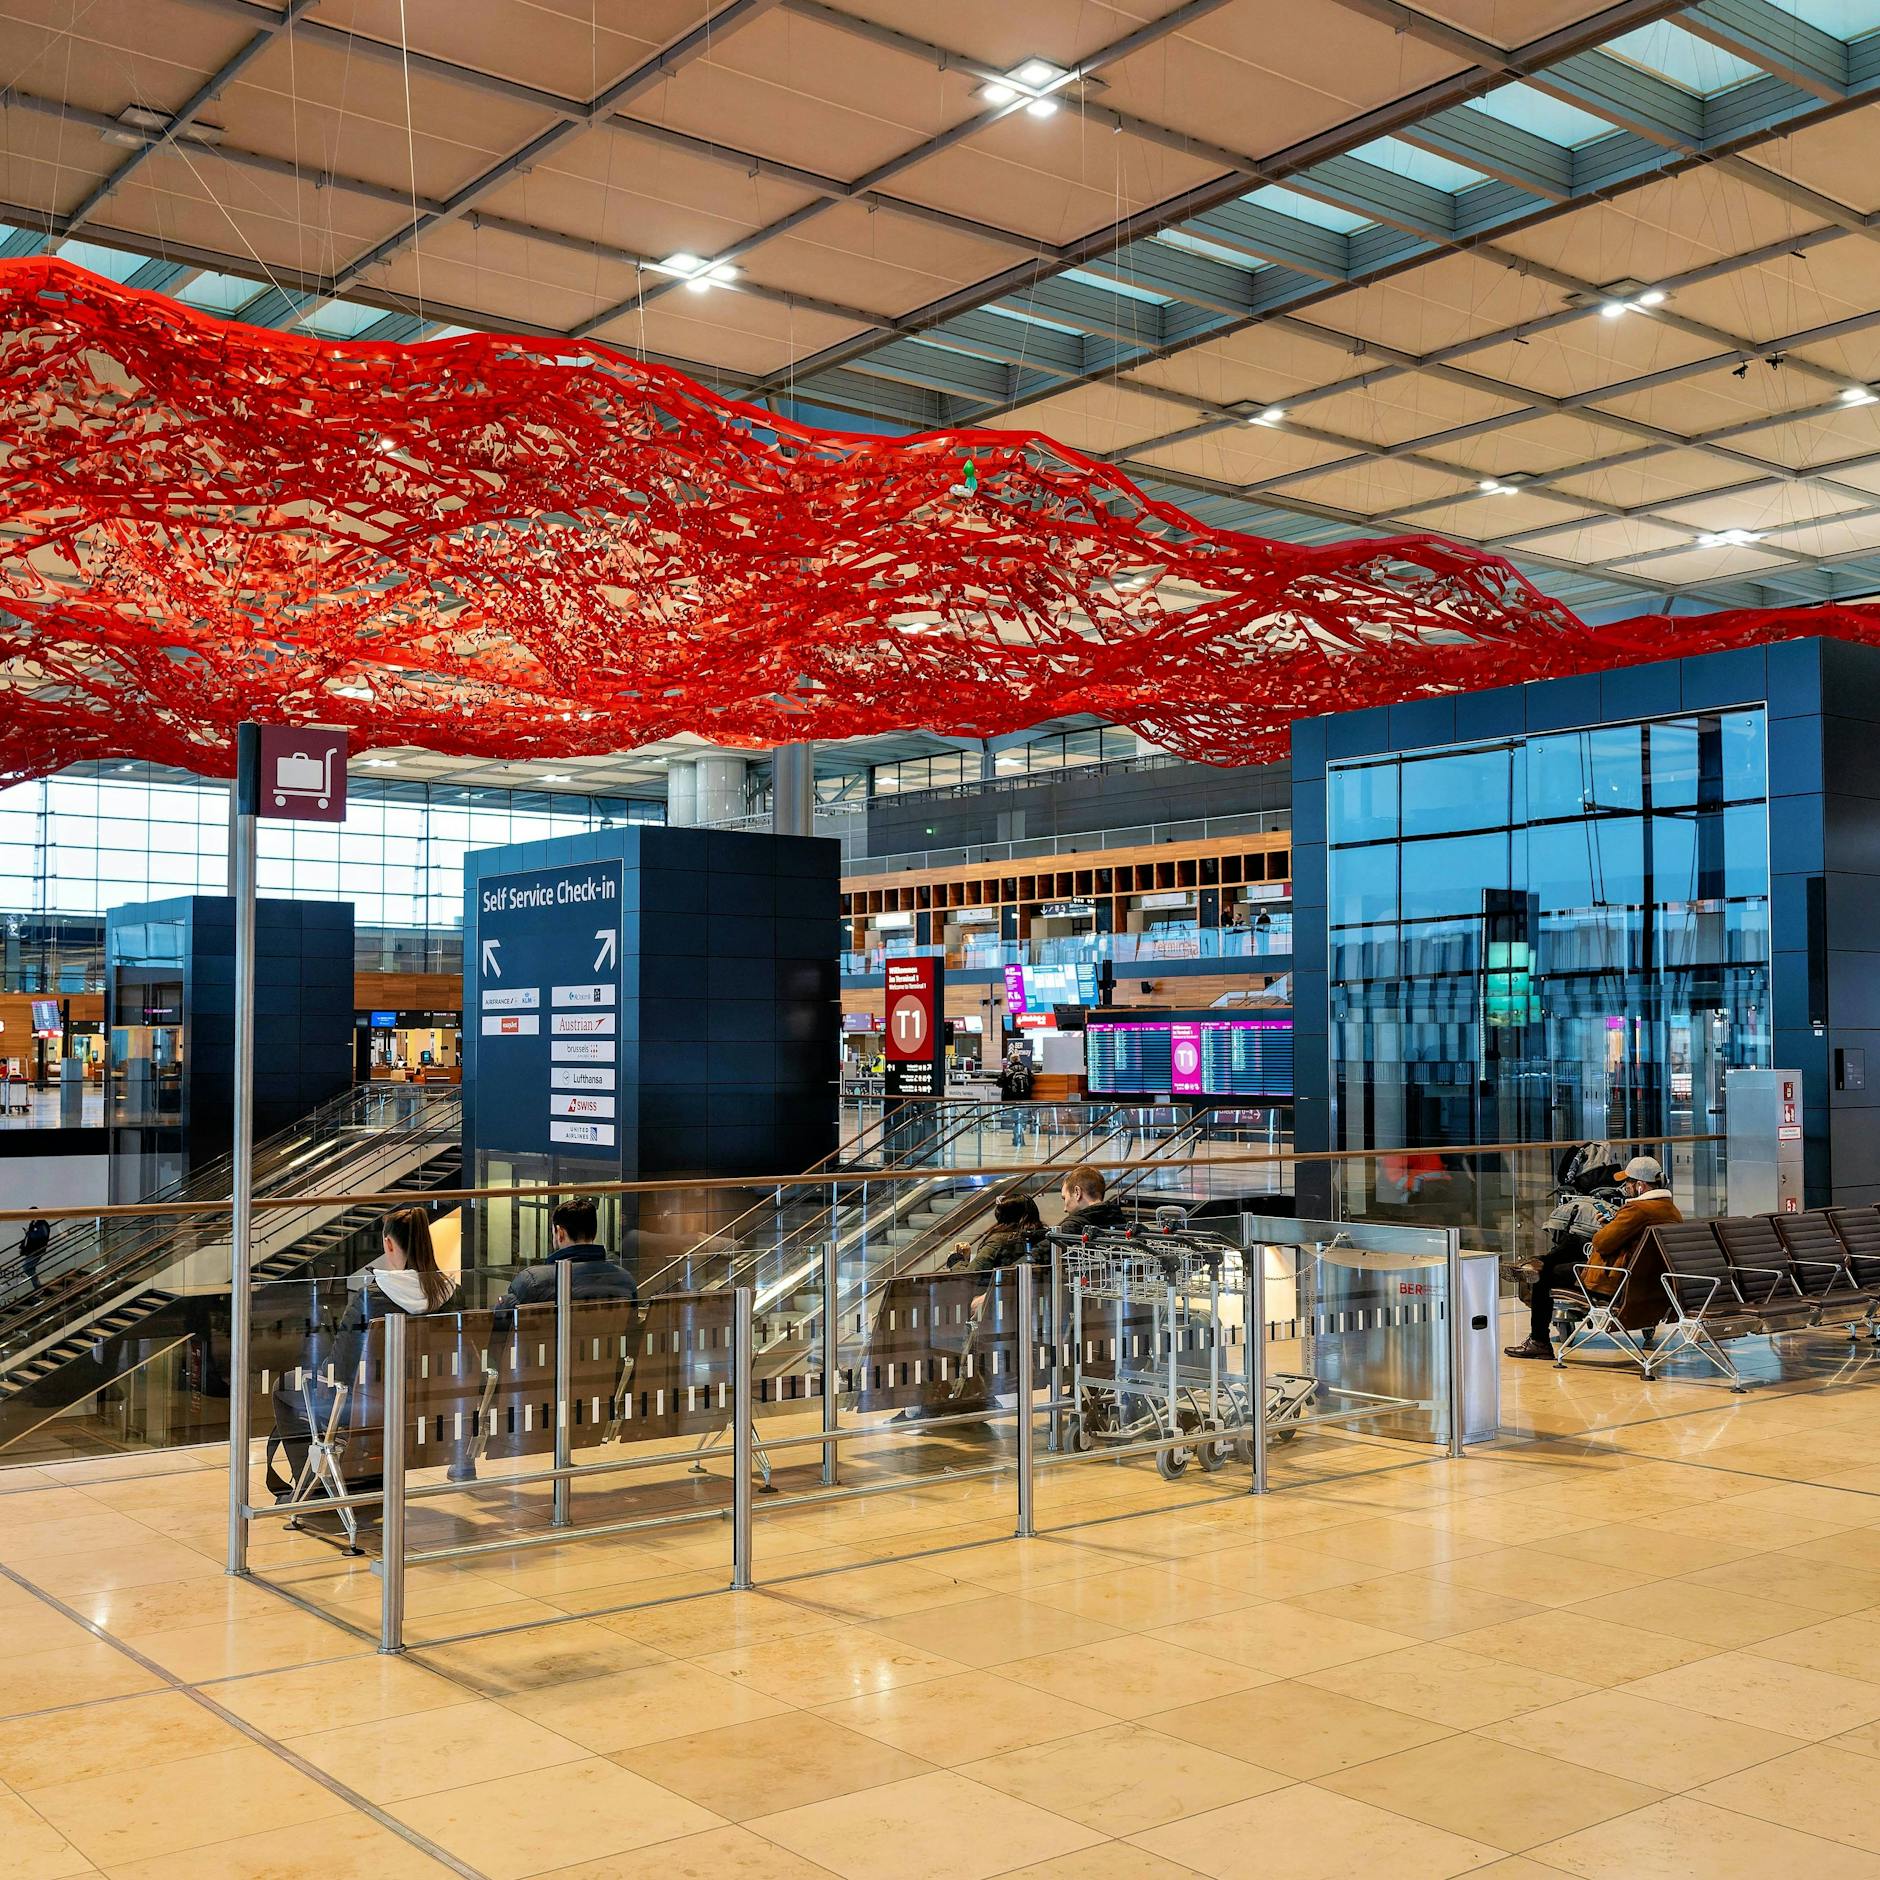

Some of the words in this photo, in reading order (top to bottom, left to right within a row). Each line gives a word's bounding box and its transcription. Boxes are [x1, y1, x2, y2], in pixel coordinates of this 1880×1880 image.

[483, 887, 507, 913] Self
[509, 883, 554, 910] Service
[557, 874, 616, 904] Check-in
[559, 1017, 593, 1032] Austrian
[895, 1010, 921, 1039] T1
[566, 1044, 589, 1053] brussels
[1177, 1050, 1194, 1067] T1
[573, 1073, 603, 1084] Lufthansa
[577, 1101, 597, 1111] SWISS
[1399, 1282, 1423, 1295] BER
